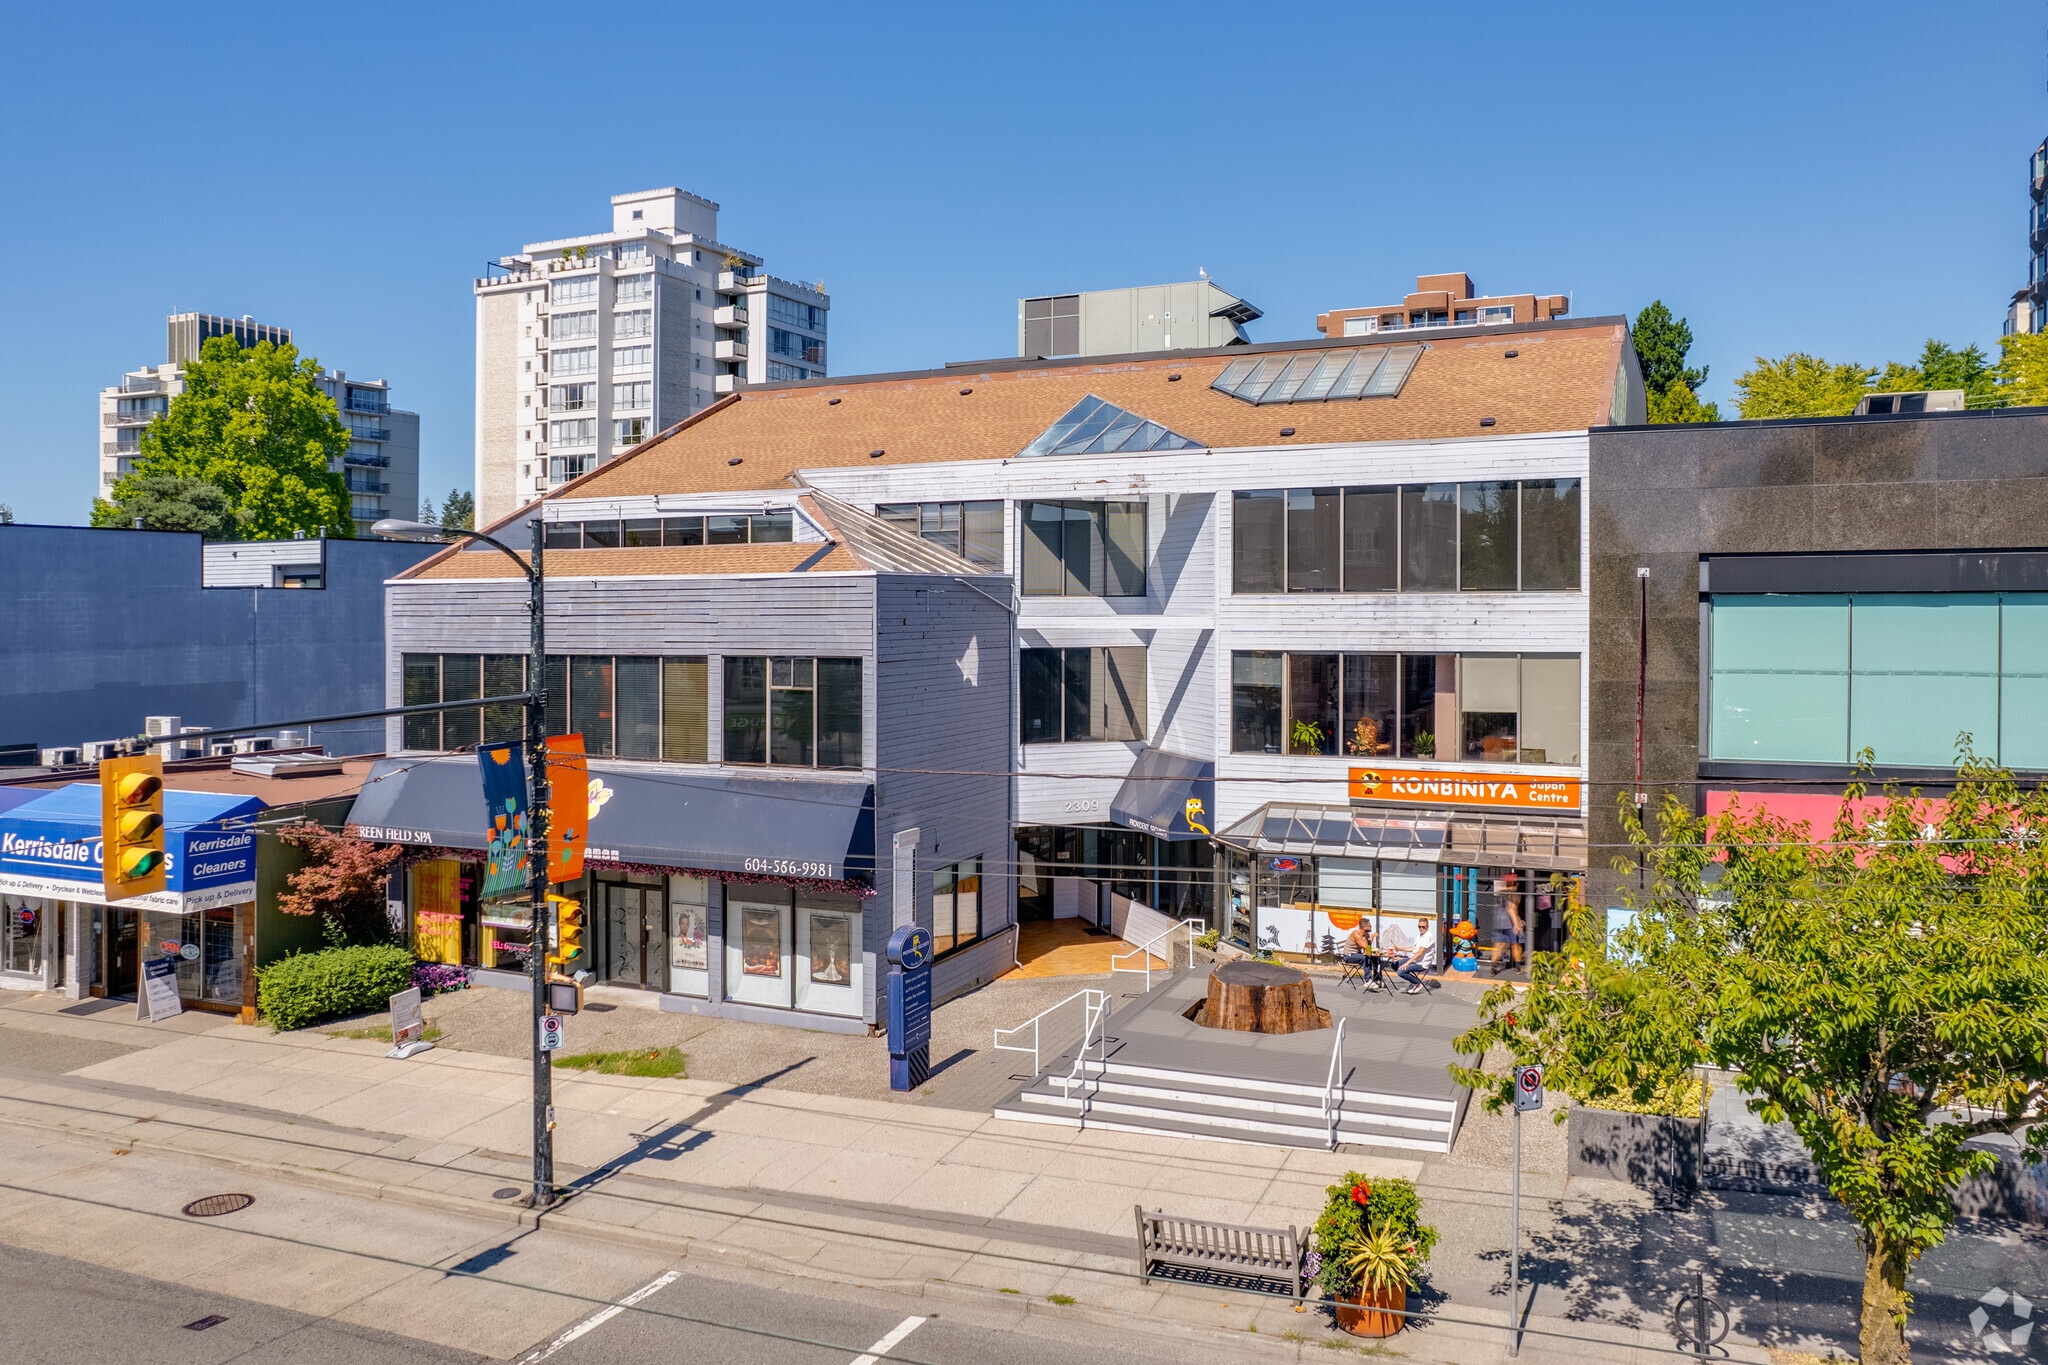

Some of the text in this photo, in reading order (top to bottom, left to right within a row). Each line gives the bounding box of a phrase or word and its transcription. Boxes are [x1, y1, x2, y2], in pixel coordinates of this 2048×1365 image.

[1392, 776, 1518, 799] KONBINIYA
[1530, 779, 1566, 791] Japan
[1529, 791, 1569, 803] Centre
[1065, 801, 1099, 813] 2309
[189, 834, 251, 853] Kerrisdale
[360, 826, 433, 844] REEN FIELD SPA
[3, 833, 89, 862] Kerrisdale
[193, 859, 247, 876] Cleaners
[745, 858, 832, 877] 604-566-9981
[186, 896, 203, 904] Pick
[205, 895, 215, 903] up
[224, 887, 253, 898] Delivery
